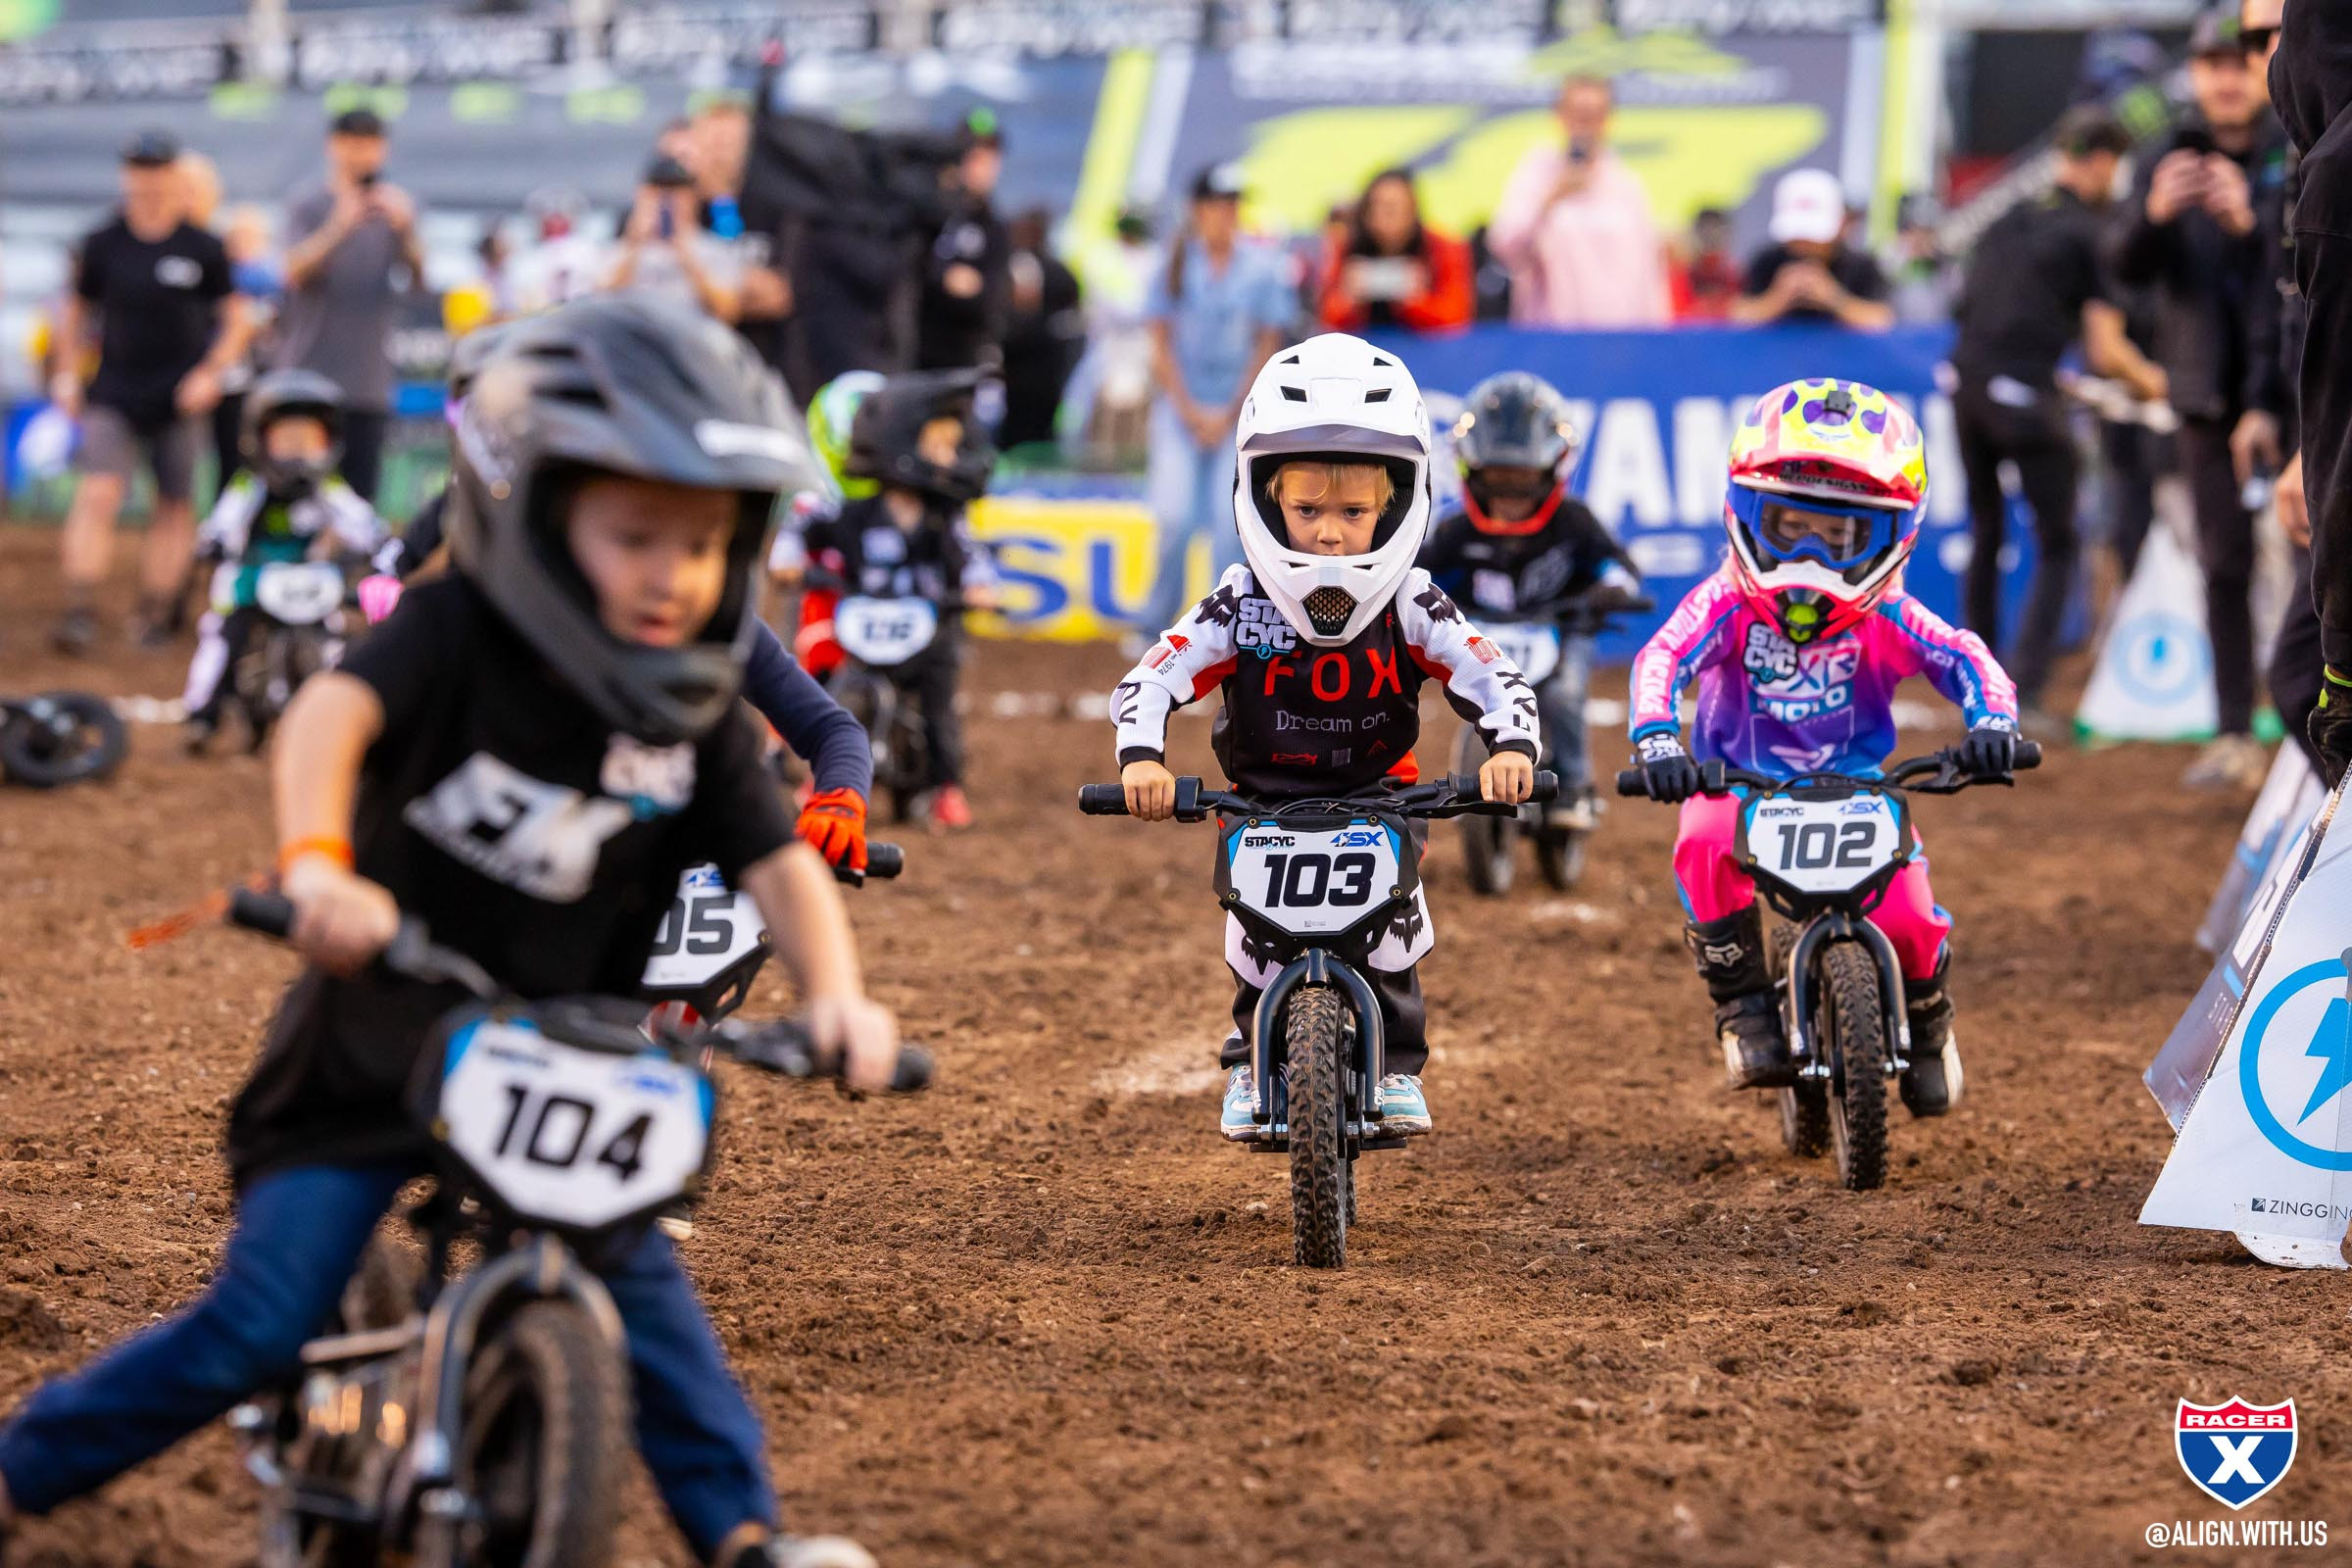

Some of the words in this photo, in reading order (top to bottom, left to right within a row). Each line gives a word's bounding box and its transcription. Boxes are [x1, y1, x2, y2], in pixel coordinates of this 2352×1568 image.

[1236, 621, 1297, 650] CYC
[1157, 660, 1176, 676] 1974
[1264, 645, 1402, 702] FOX
[1275, 710, 1351, 733] Dream
[1361, 711, 1391, 730] on.
[1245, 836, 1296, 848] STACYC
[1778, 821, 1877, 870] 102
[1263, 852, 1376, 908] 103
[496, 1084, 654, 1184] 104
